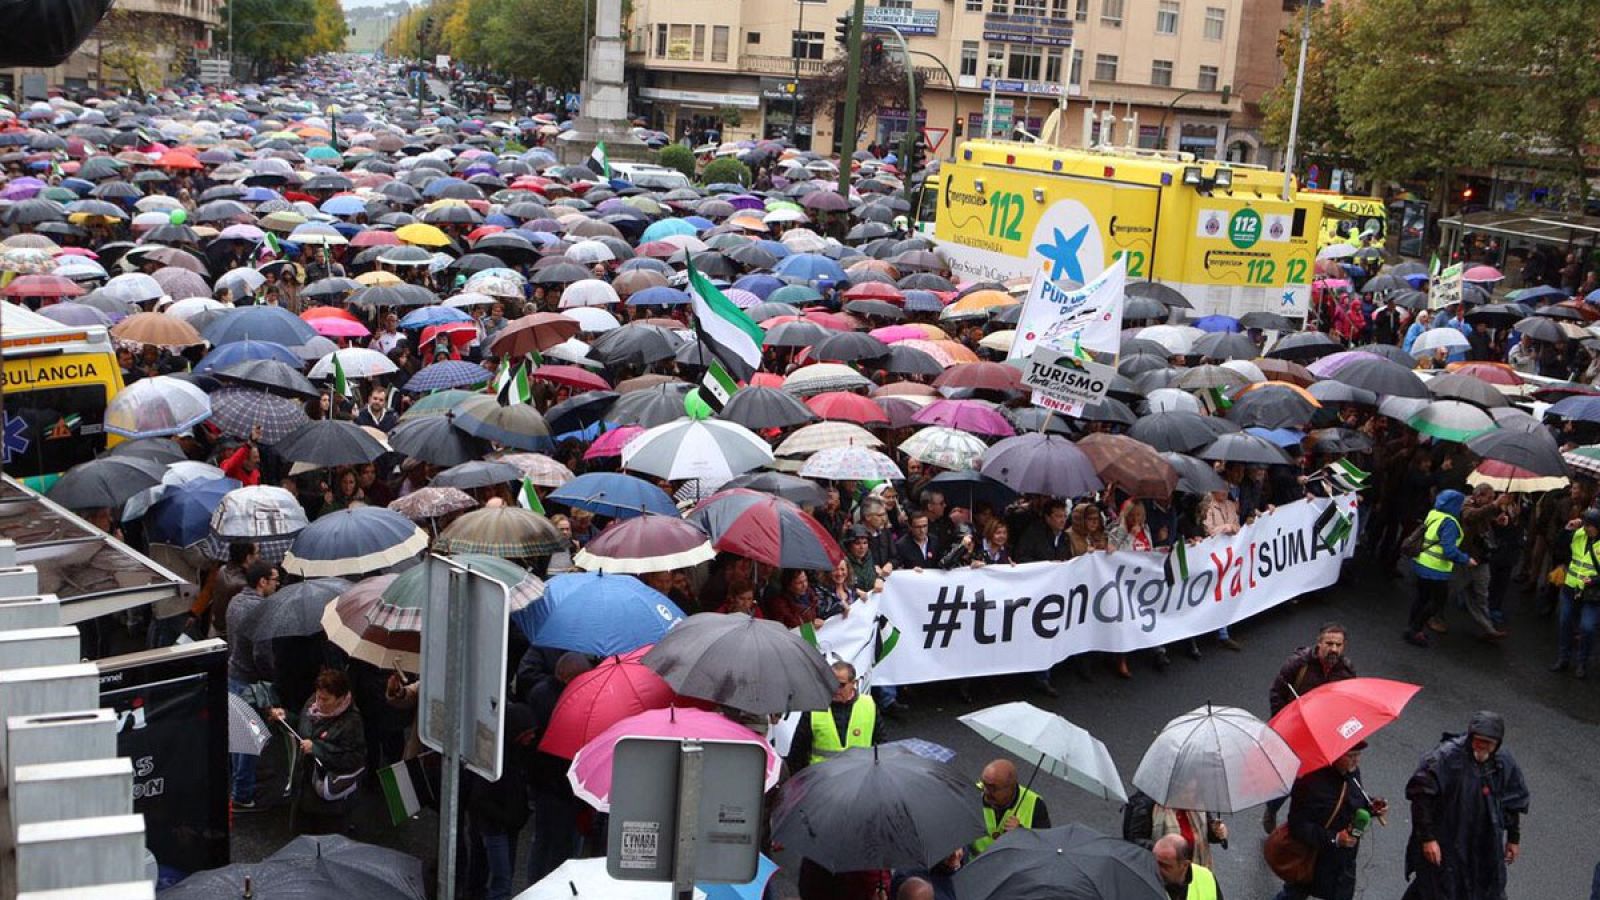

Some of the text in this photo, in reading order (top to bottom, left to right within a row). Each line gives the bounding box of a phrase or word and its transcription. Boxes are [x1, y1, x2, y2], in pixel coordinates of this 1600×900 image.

[988, 190, 1025, 241] 112
[1350, 203, 1375, 215] DYA
[1235, 216, 1257, 232] 112
[963, 261, 982, 275] Social
[1247, 258, 1276, 284] 112
[1031, 362, 1104, 393] TURISMO
